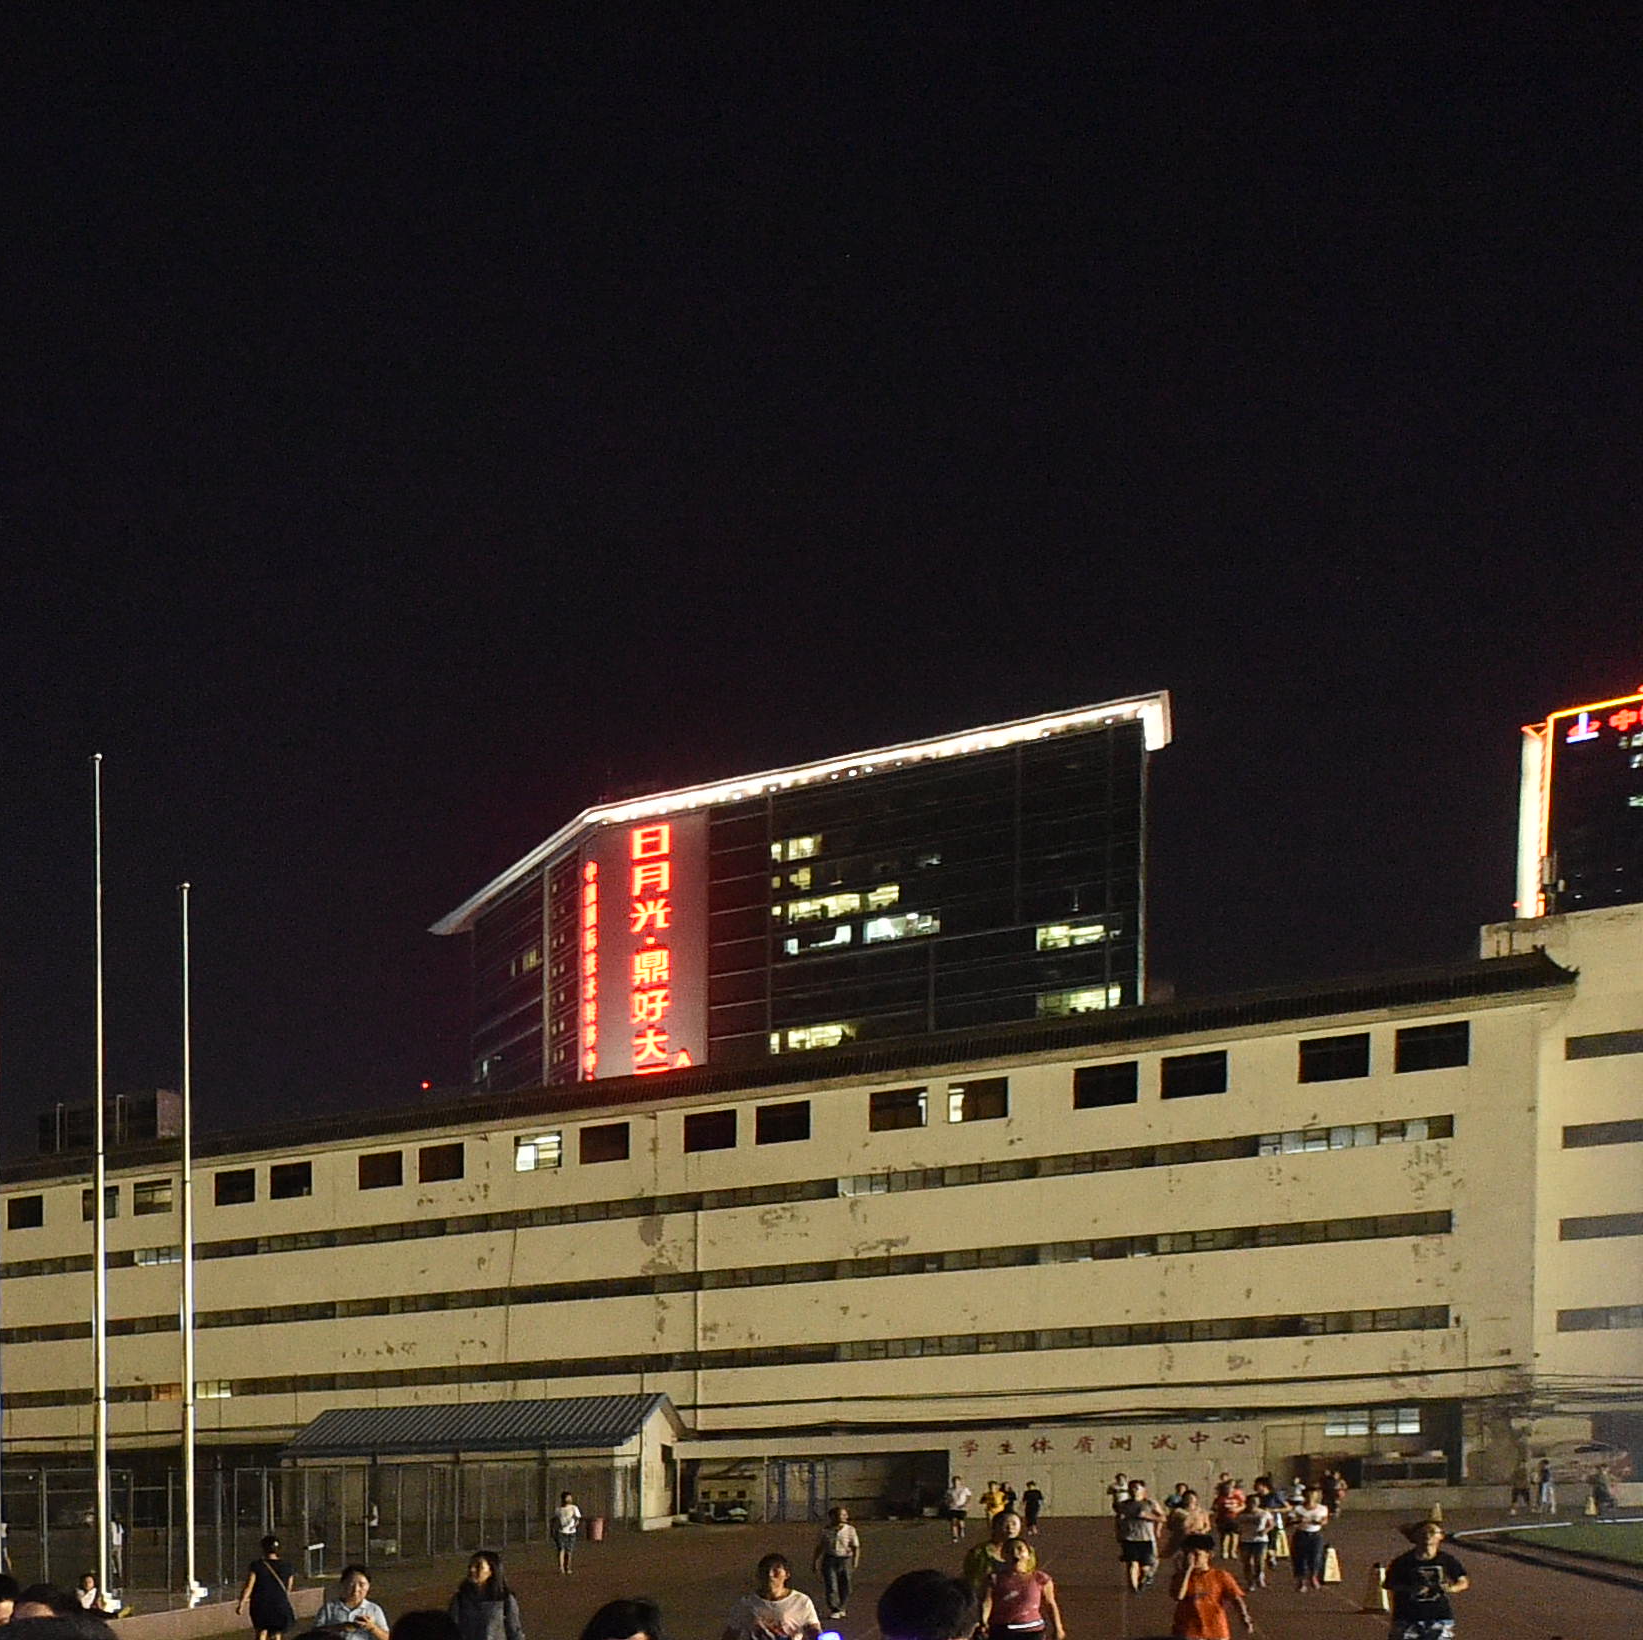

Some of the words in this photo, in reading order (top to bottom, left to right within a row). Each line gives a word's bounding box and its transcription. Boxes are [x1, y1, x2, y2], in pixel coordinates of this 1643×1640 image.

[629, 822, 672, 1076] 日月光·鼎好大
[958, 1431, 1251, 1458] 学生体质测试中心
